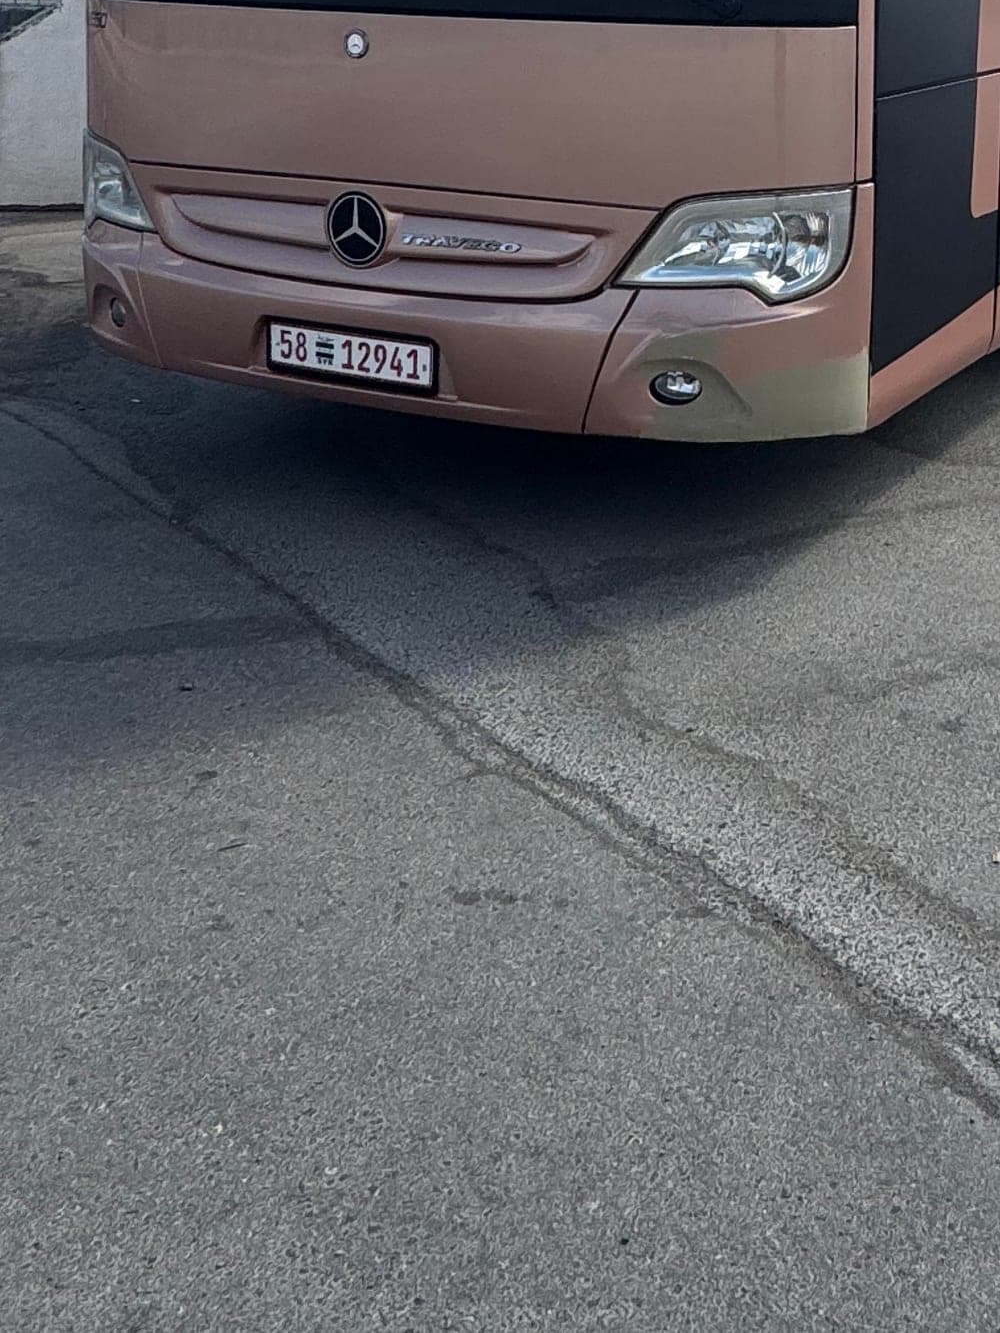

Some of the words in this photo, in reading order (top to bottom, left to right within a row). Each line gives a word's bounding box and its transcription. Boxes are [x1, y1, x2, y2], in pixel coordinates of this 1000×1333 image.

[401, 233, 522, 254] TRAVEGO
[280, 329, 307, 362] 58
[341, 339, 420, 380] 12941
